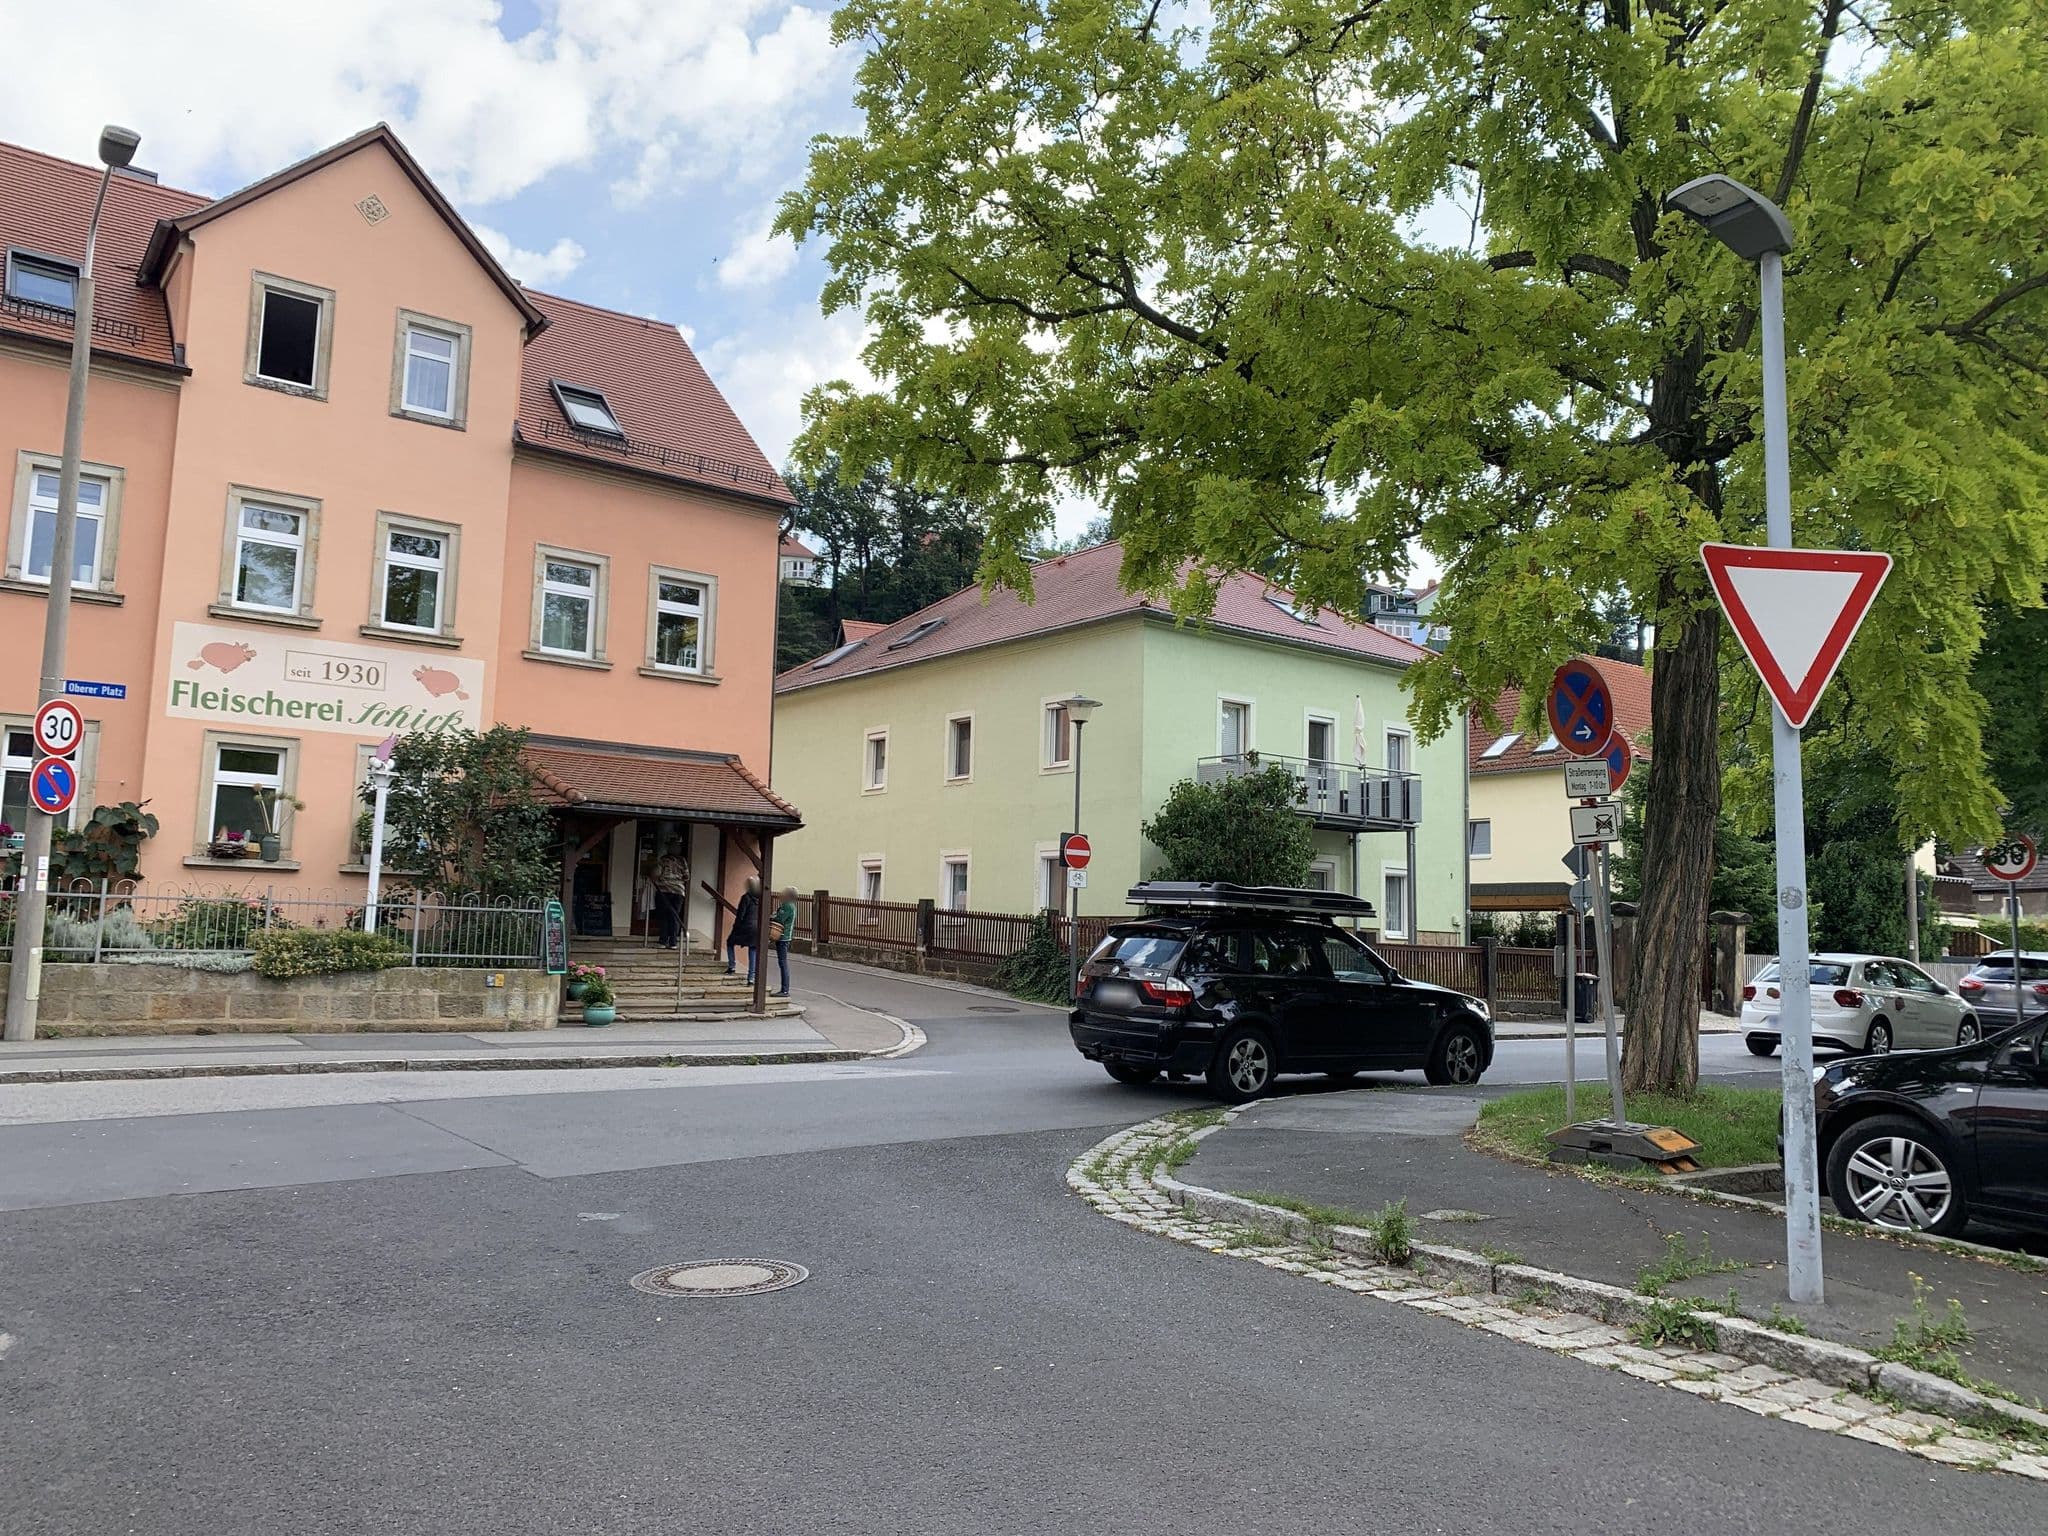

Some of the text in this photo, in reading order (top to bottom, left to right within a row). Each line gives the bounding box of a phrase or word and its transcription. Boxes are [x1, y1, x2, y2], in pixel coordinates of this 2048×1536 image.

[290, 661, 380, 686] seit 1930
[68, 682, 123, 697] Oberer Platz
[171, 679, 465, 735] Fleischerei Schick
[45, 715, 73, 741] 30
